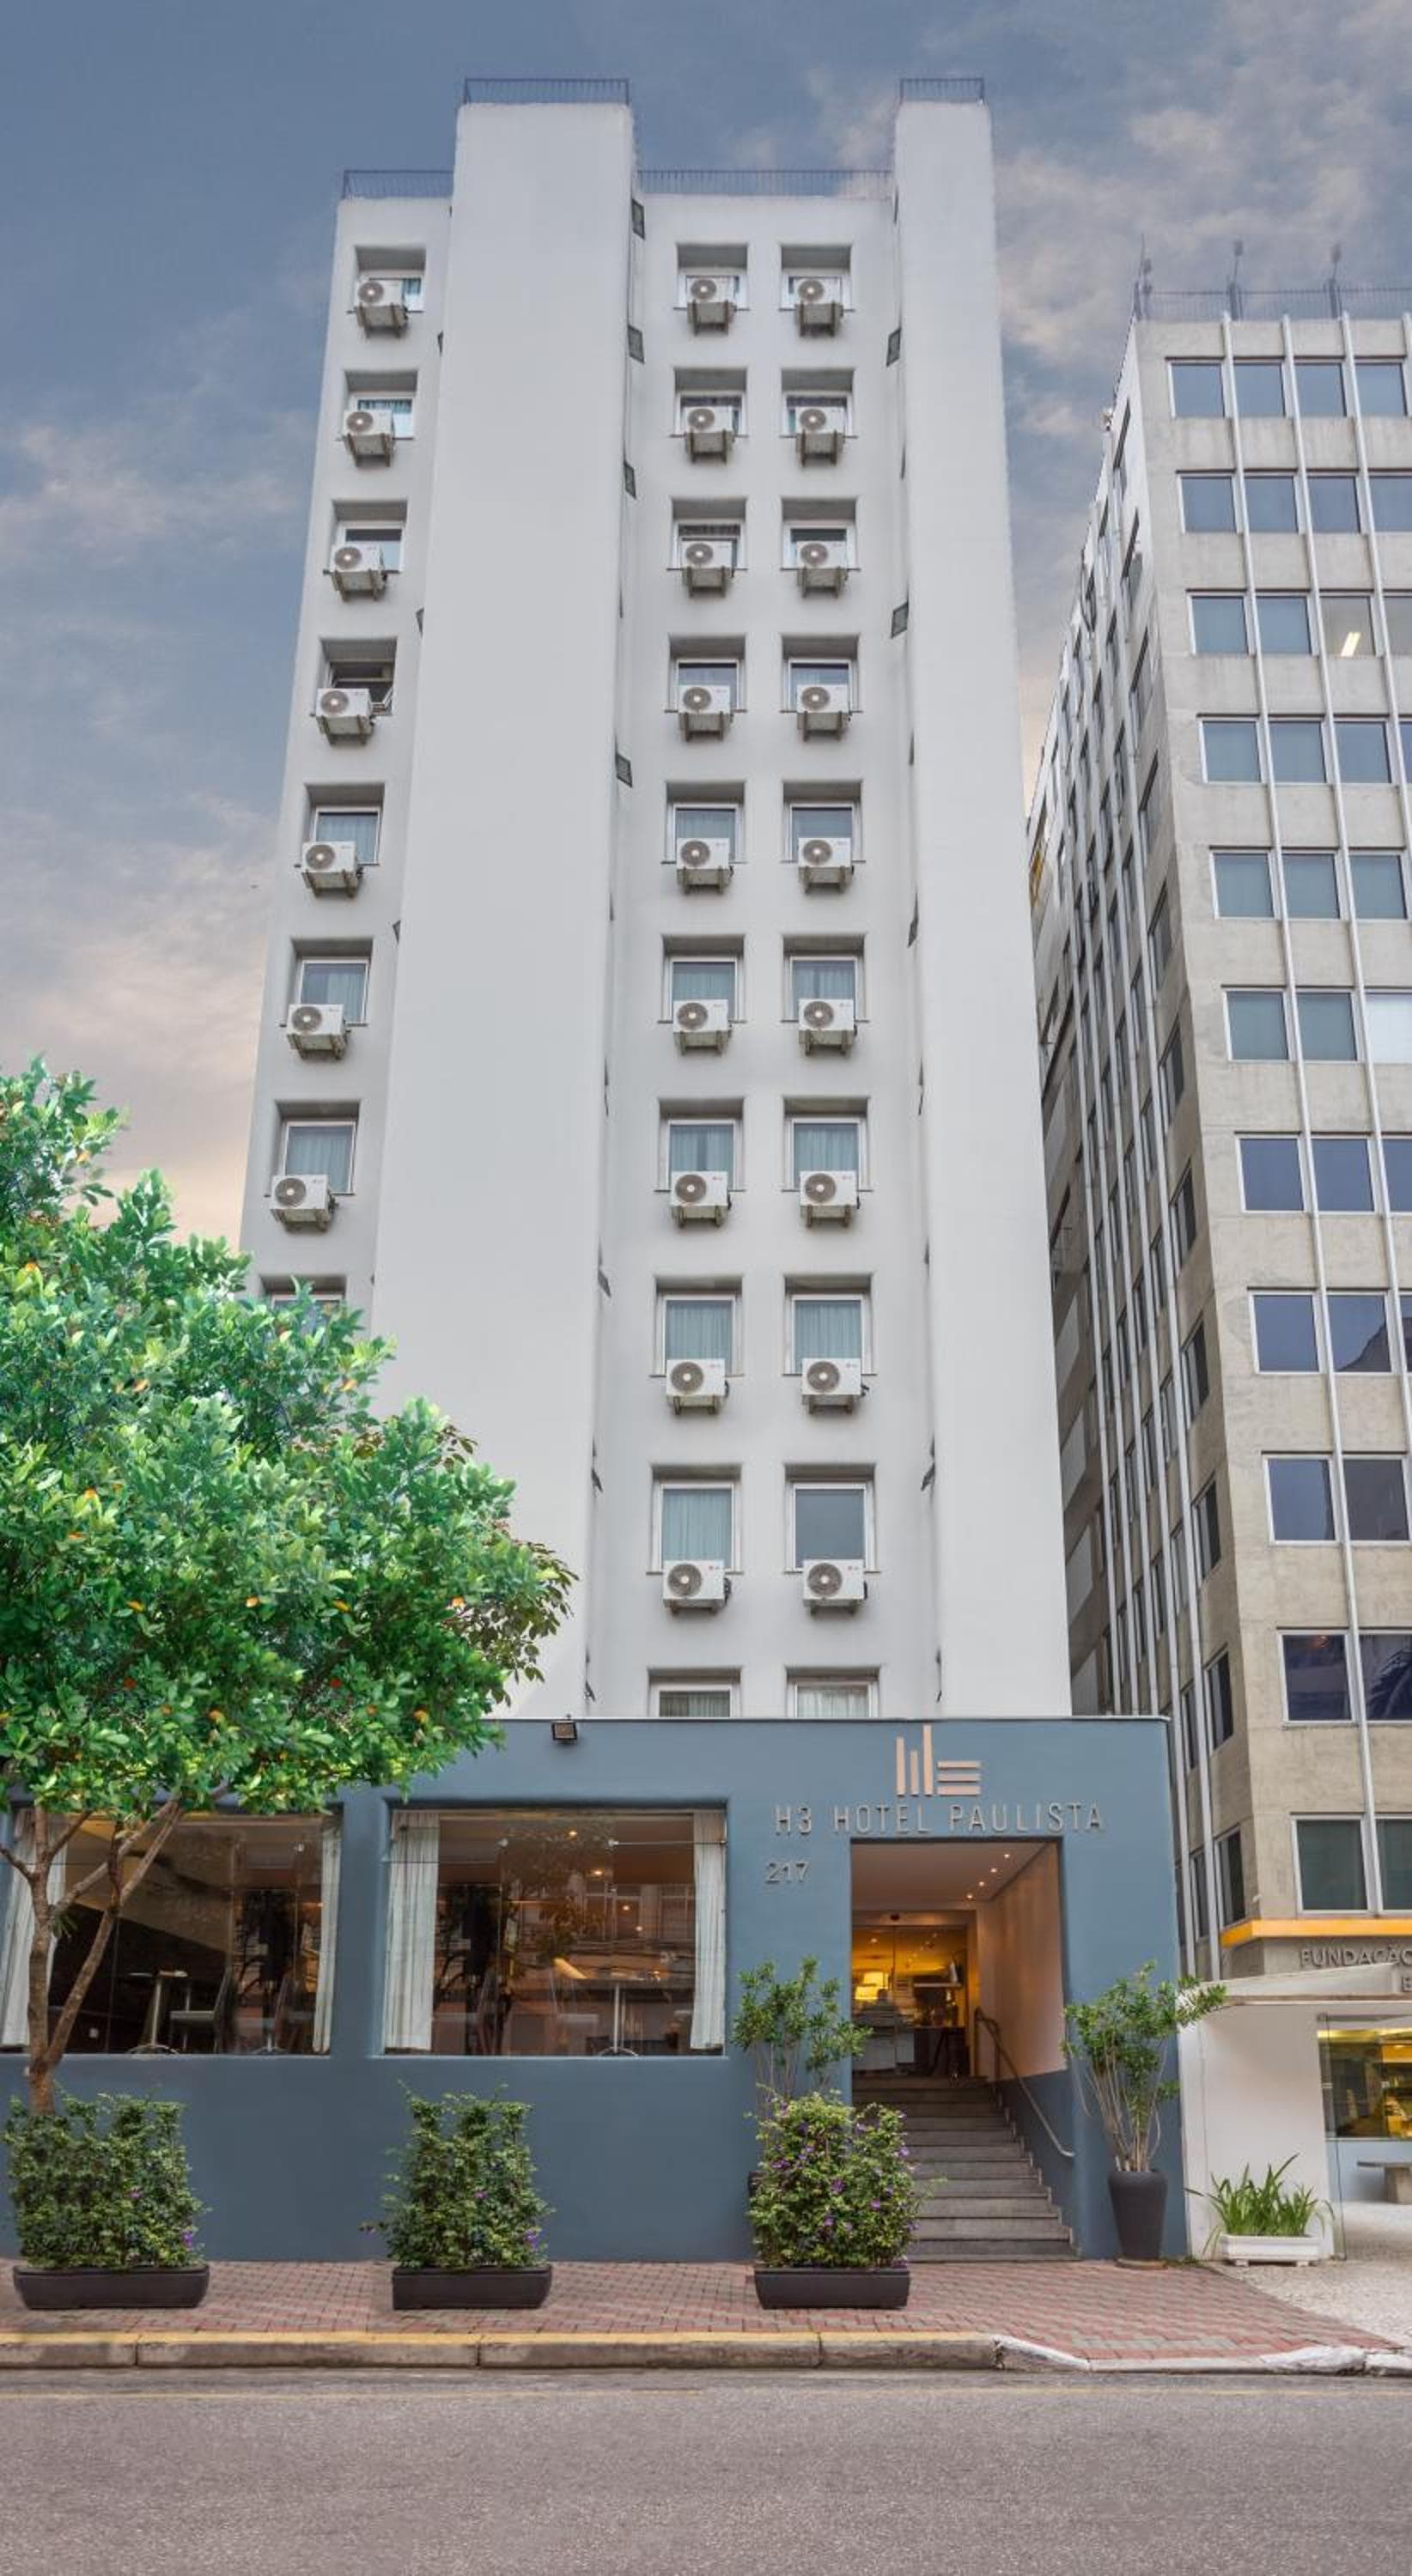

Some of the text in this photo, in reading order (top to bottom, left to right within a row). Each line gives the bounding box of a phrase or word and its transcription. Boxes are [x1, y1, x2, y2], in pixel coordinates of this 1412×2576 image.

[776, 1803, 1103, 1836] H3 HOTEL PAULISTA
[765, 1861, 809, 1883] 217
